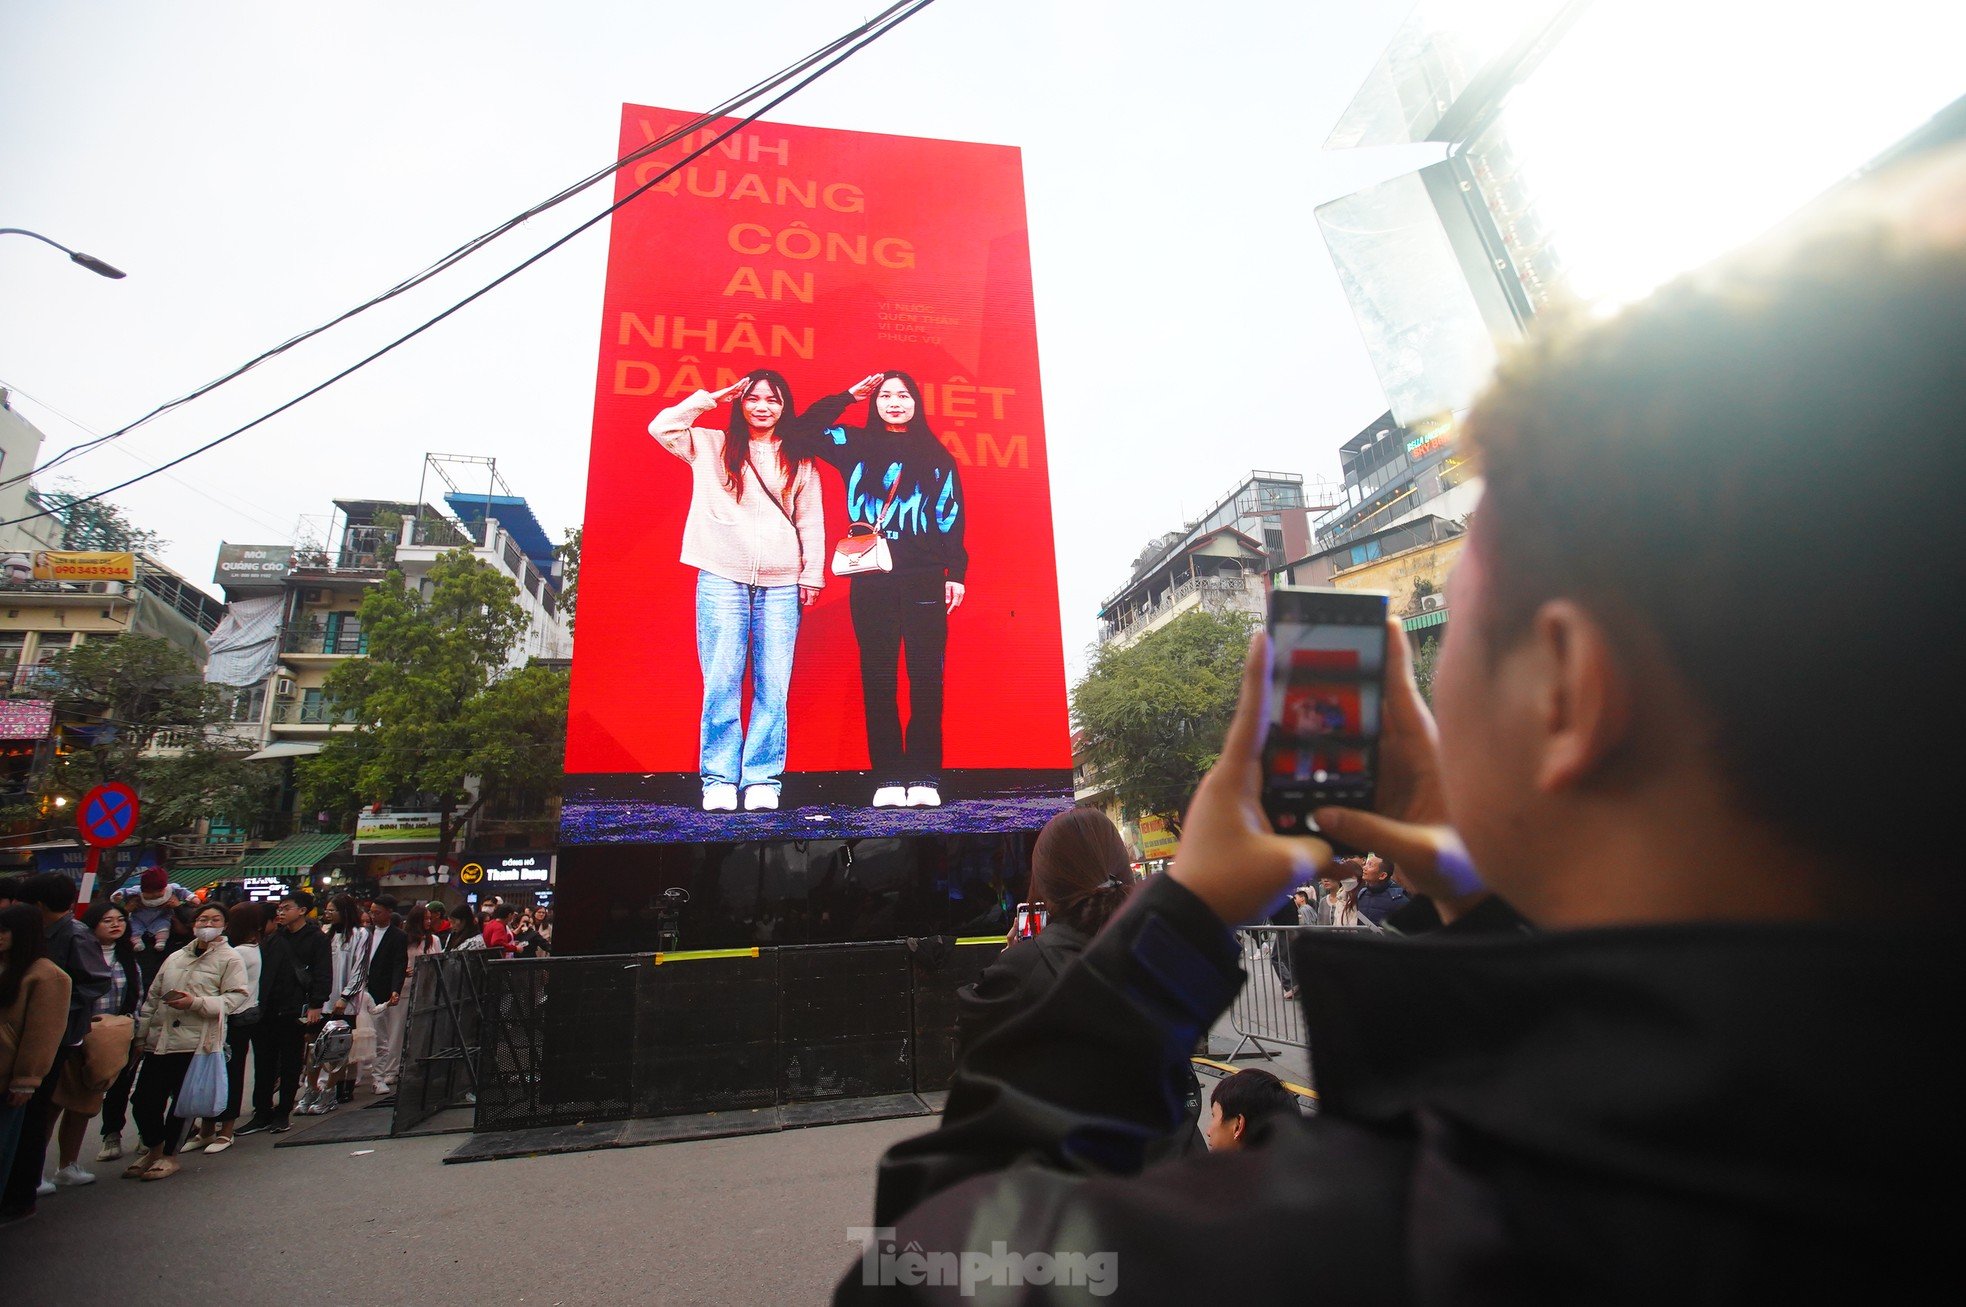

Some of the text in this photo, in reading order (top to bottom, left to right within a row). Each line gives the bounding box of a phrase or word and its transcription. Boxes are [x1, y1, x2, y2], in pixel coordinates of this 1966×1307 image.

[639, 119, 789, 166] VINH
[634, 161, 865, 214] QUANG
[727, 220, 916, 269] CÔNG
[723, 266, 814, 303] AN
[617, 312, 815, 360] NHÂN
[921, 375, 1016, 427] IỆT
[940, 430, 1029, 469] AM
[55, 566, 129, 575] 090 343 9344
